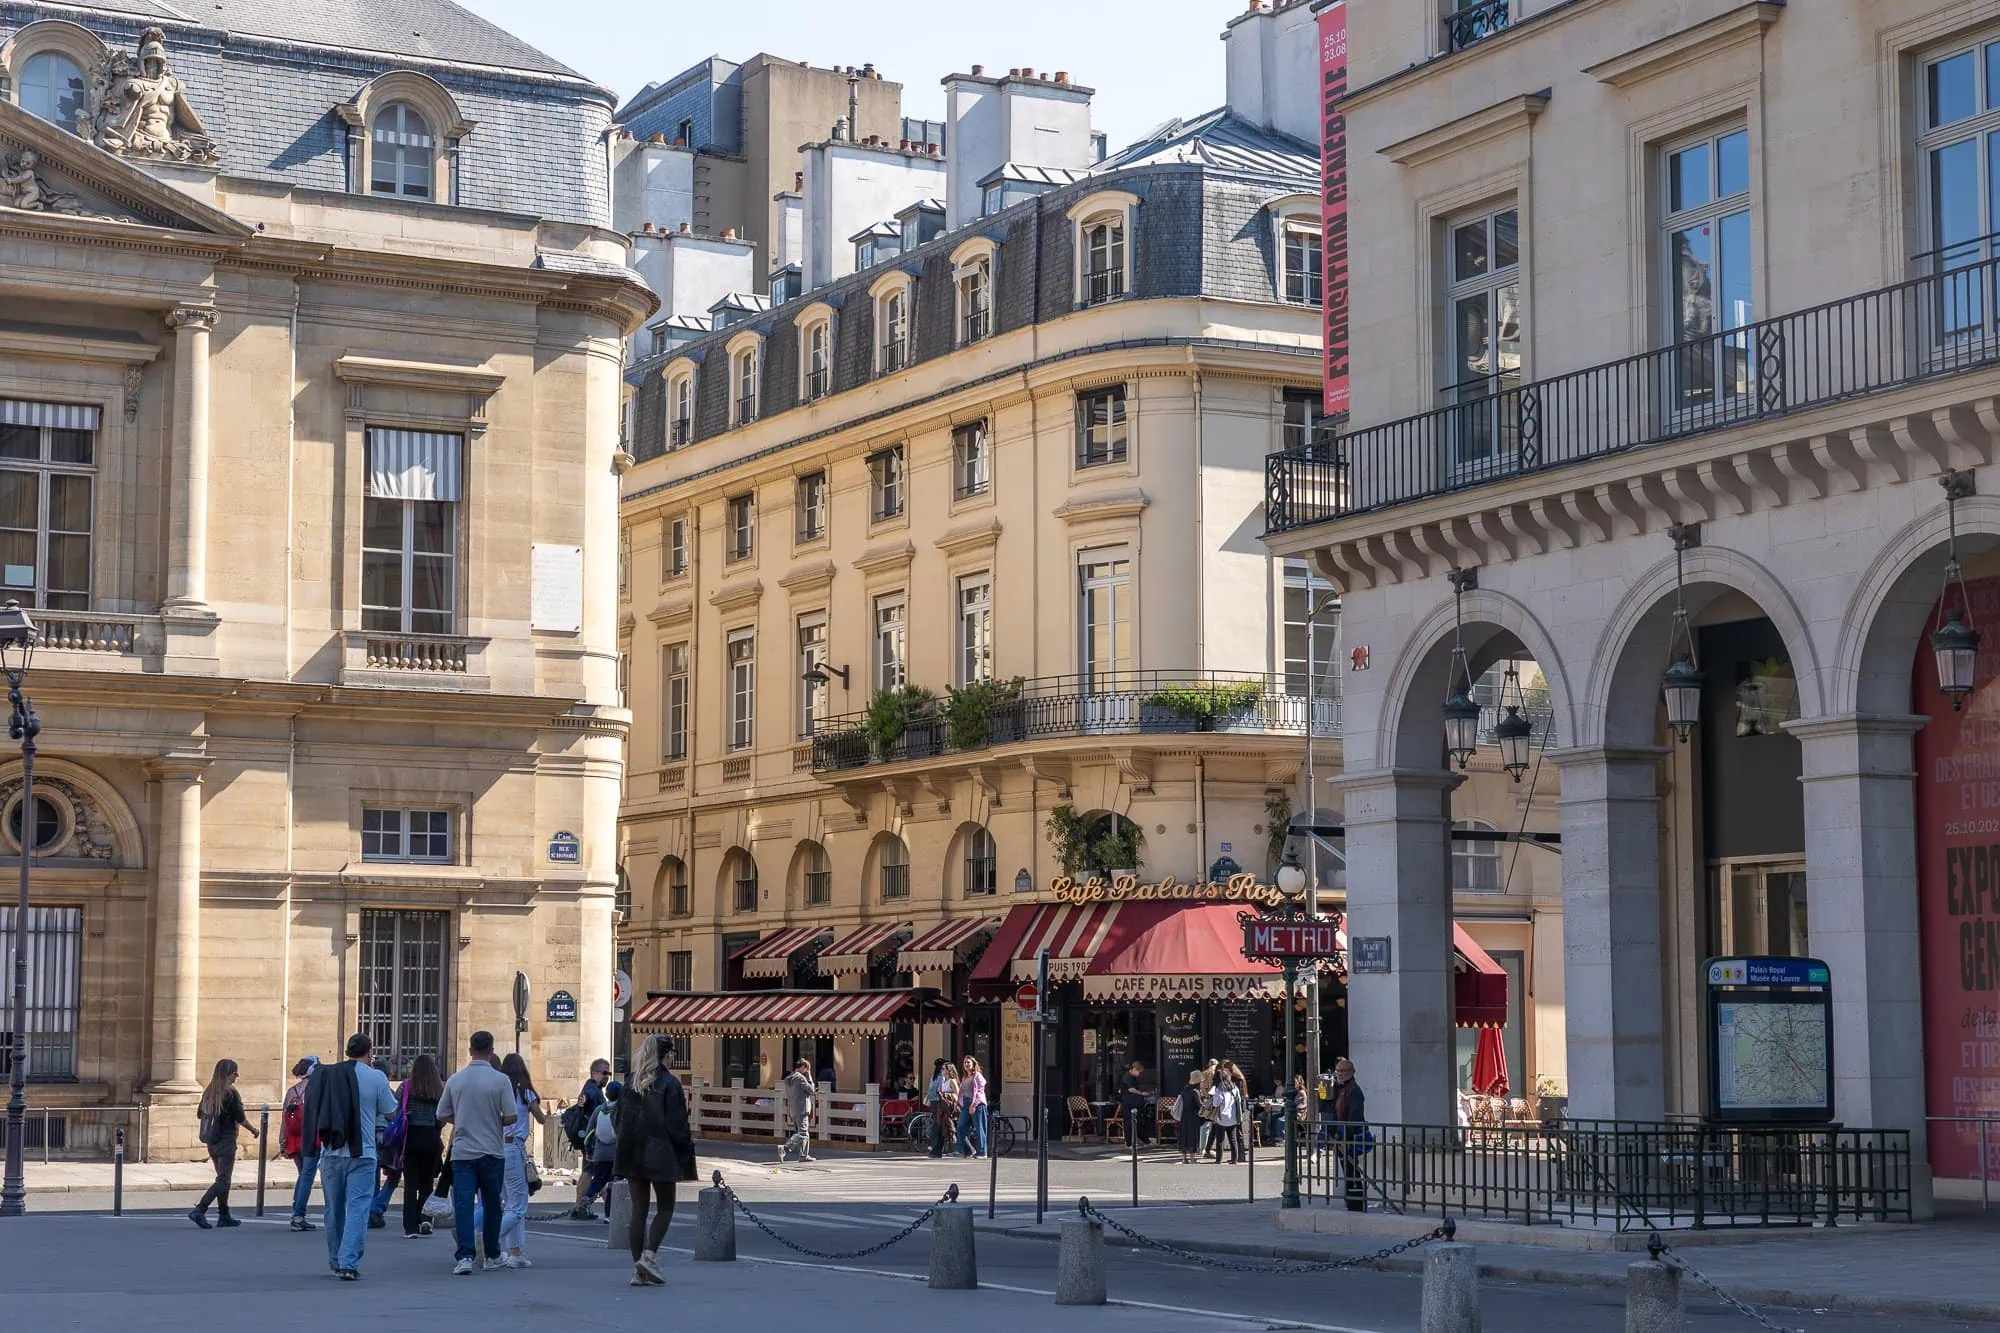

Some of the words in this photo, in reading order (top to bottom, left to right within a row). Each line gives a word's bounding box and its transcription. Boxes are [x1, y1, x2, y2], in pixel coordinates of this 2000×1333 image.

[1050, 876, 1105, 906] Café
[1110, 874, 1219, 900] Palais
[1226, 872, 1319, 907] Roy
[1946, 844, 2000, 915] EXPO
[1254, 926, 1331, 953] METRO
[1960, 916, 2000, 991] GÉN
[1750, 966, 1768, 974] Palais
[1769, 966, 1786, 975] Royal
[1750, 974, 1770, 982] Musée
[1780, 975, 1801, 983] Louvre
[1114, 975, 1145, 991] CAFÉ
[1150, 977, 1205, 991] PALAIS
[1212, 977, 1267, 991] ROYAL
[1165, 1012, 1197, 1024] CAFÉ
